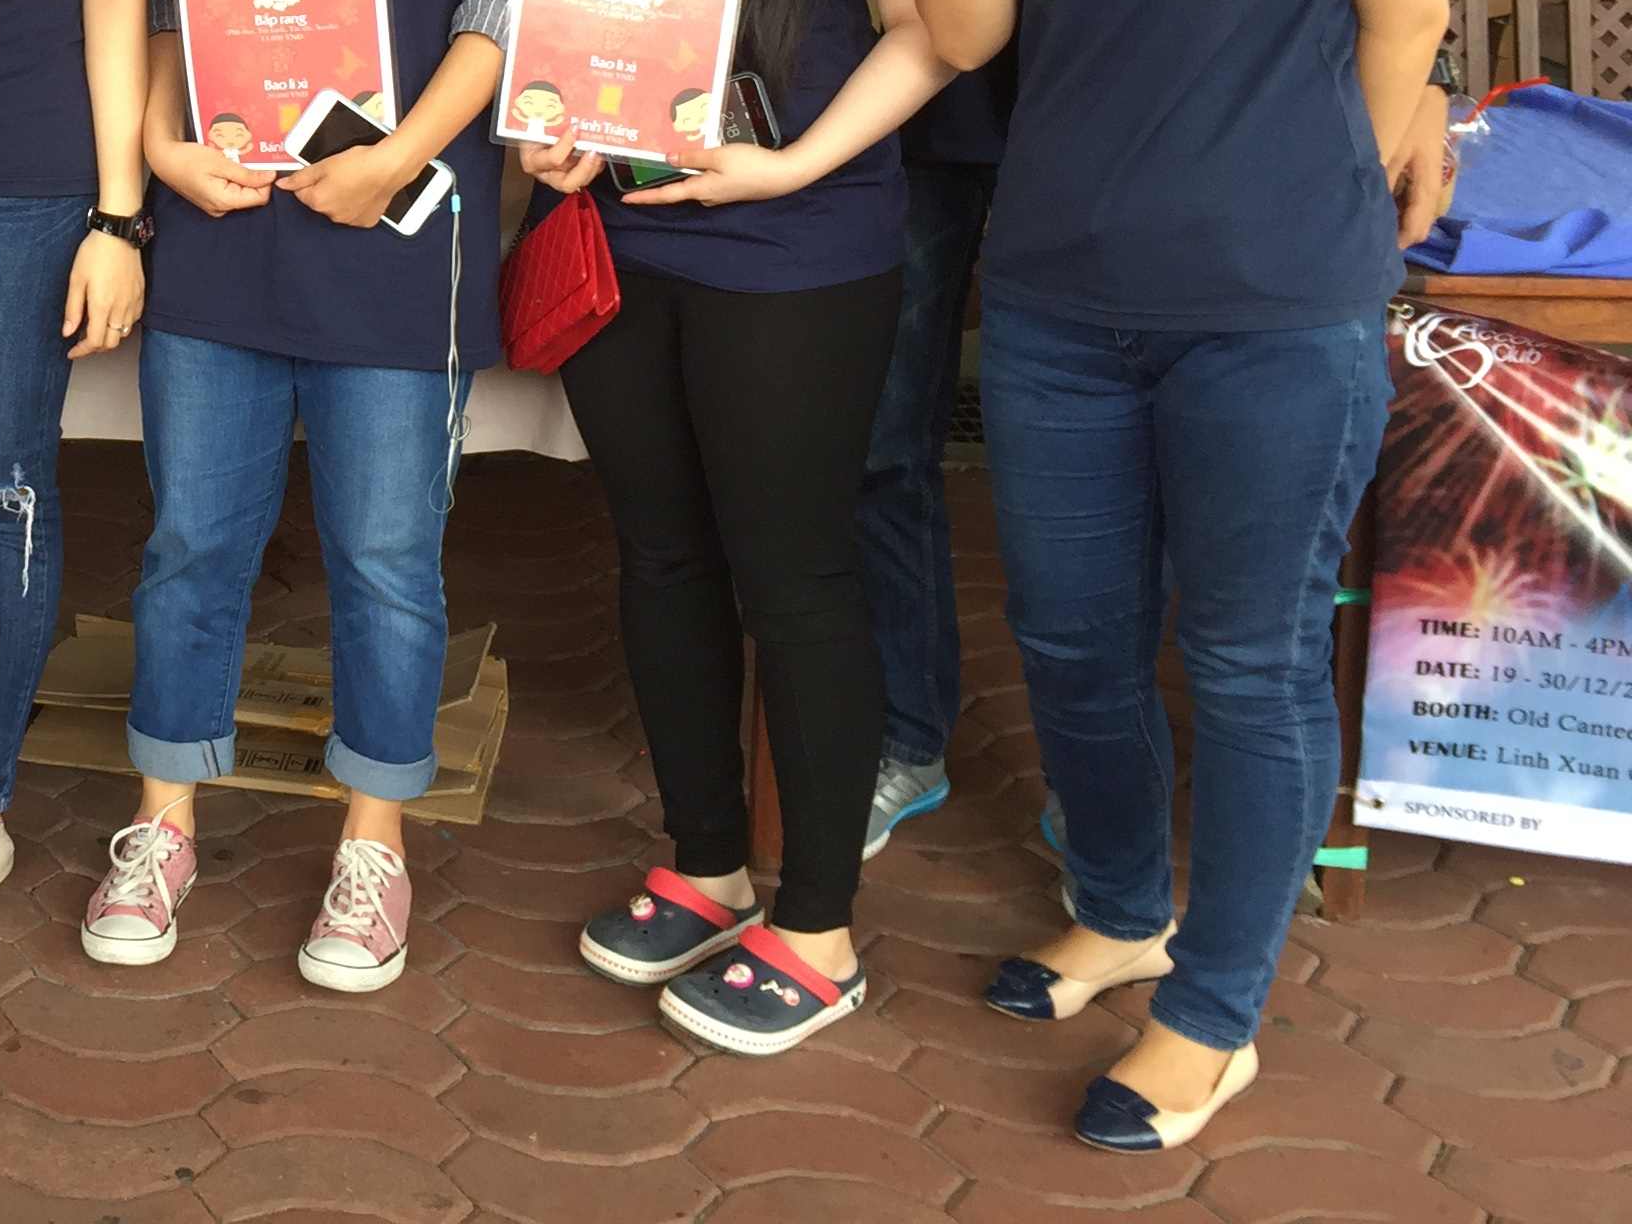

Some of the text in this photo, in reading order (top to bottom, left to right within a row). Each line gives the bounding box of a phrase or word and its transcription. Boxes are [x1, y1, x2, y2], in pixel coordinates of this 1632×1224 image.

[279, 14, 308, 27] rang
[589, 55, 615, 71] Bao
[263, 79, 288, 92] Bao
[1491, 342, 1542, 365] Club
[1418, 618, 1481, 639] TIME:
[1491, 626, 1563, 650] 10AM
[1415, 660, 1481, 680] DATE:
[1492, 665, 1518, 683] 19
[1538, 671, 1632, 699] 30/12/2
[1411, 700, 1500, 722] BOOTH:
[1507, 707, 1551, 729] Old
[1408, 739, 1488, 762] VENUE:
[1495, 746, 1551, 771] Linh
[1556, 753, 1621, 781] Xuan
[1404, 800, 1544, 832] SPONSORED BY
